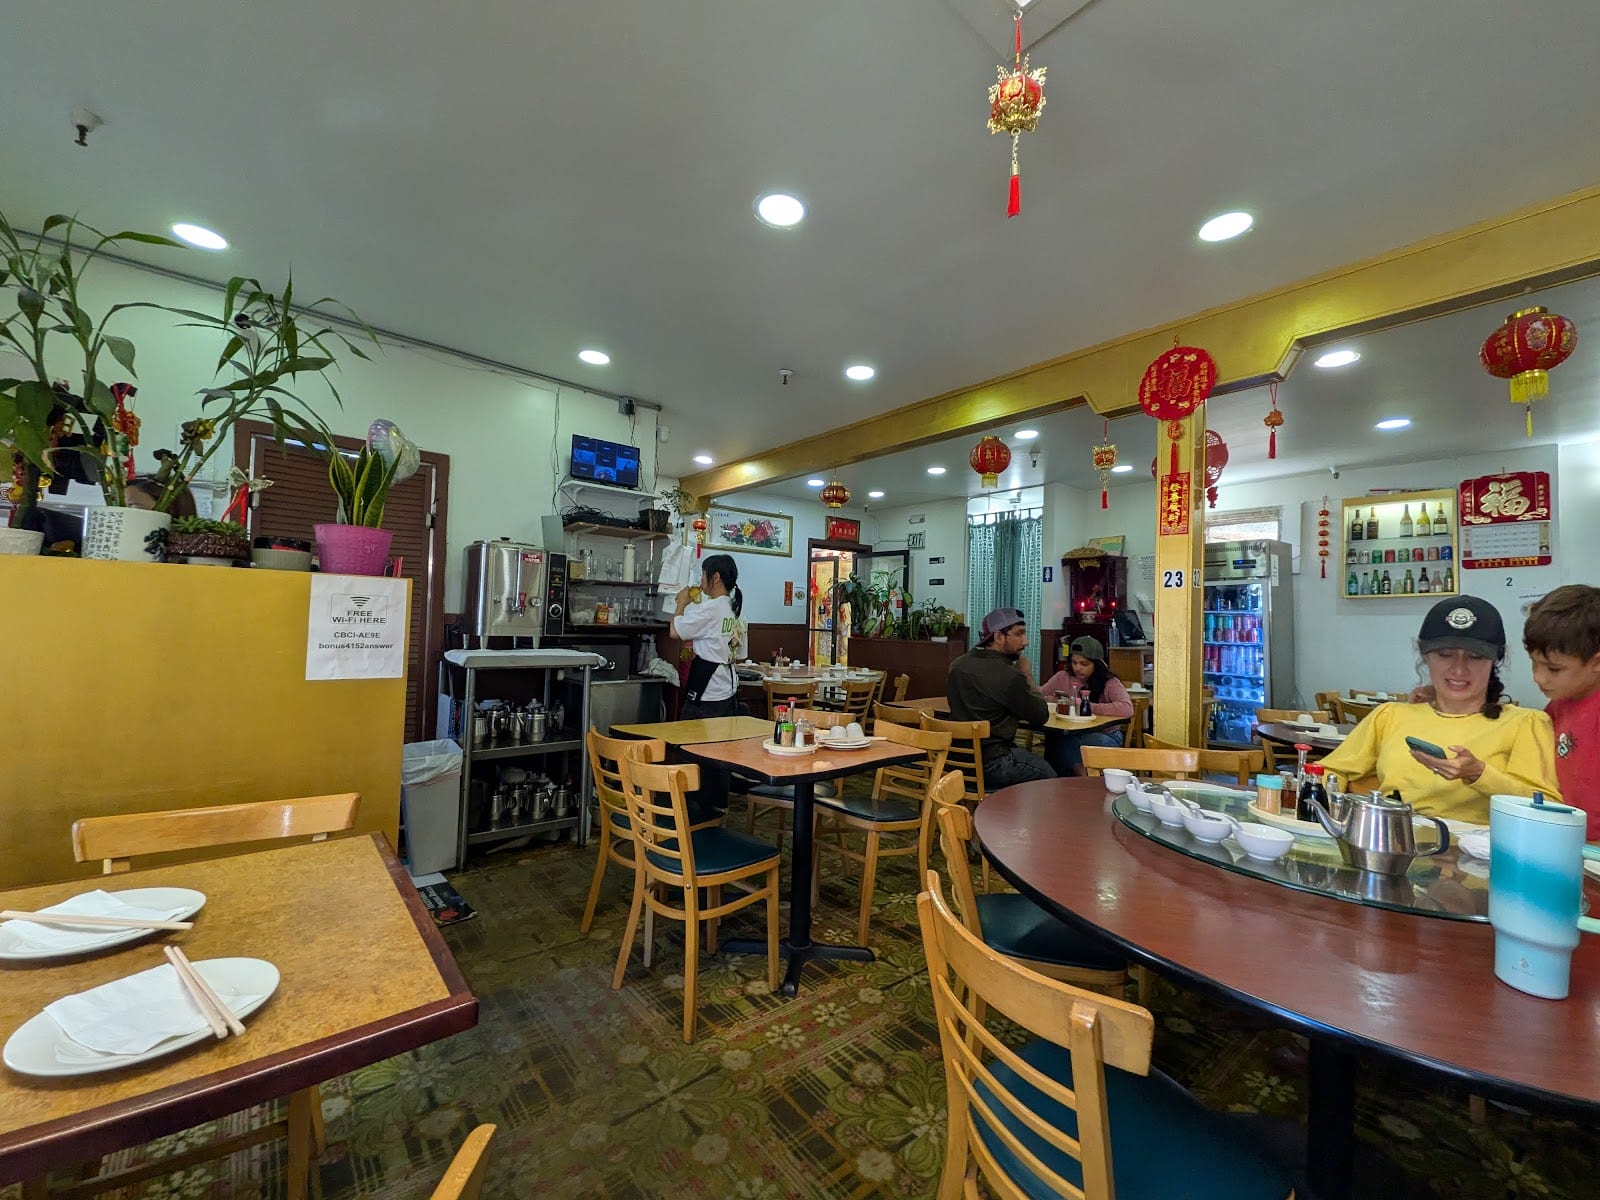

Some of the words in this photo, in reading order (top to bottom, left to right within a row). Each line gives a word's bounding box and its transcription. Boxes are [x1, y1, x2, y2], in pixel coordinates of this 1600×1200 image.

[1480, 479, 1530, 517] 福
[907, 533, 923, 547] EXIT
[1163, 570, 1183, 588] 23
[1505, 577, 1513, 587] 2
